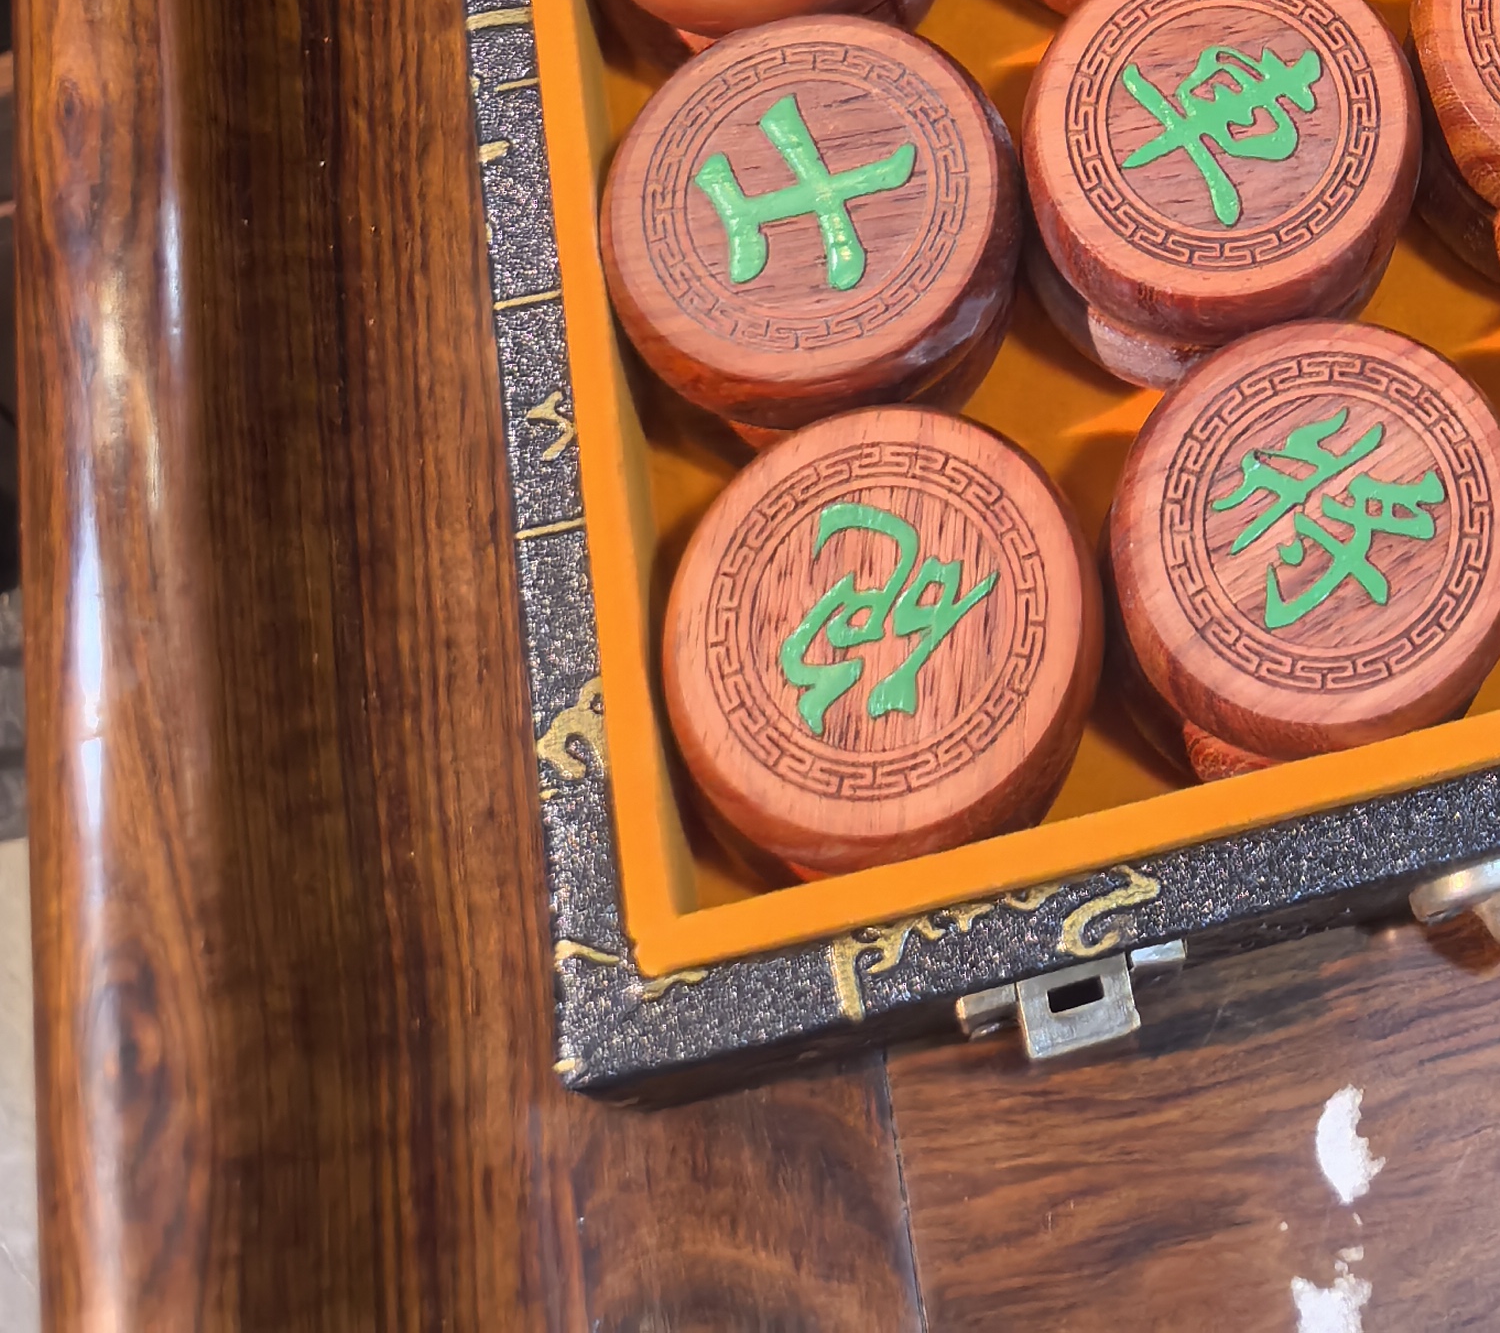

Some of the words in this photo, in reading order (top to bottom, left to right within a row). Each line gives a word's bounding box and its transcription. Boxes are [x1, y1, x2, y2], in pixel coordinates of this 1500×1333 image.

[696, 93, 916, 290] 士
[1122, 44, 1324, 227] 車
[780, 500, 999, 738] 砲
[1213, 406, 1444, 629] 將
